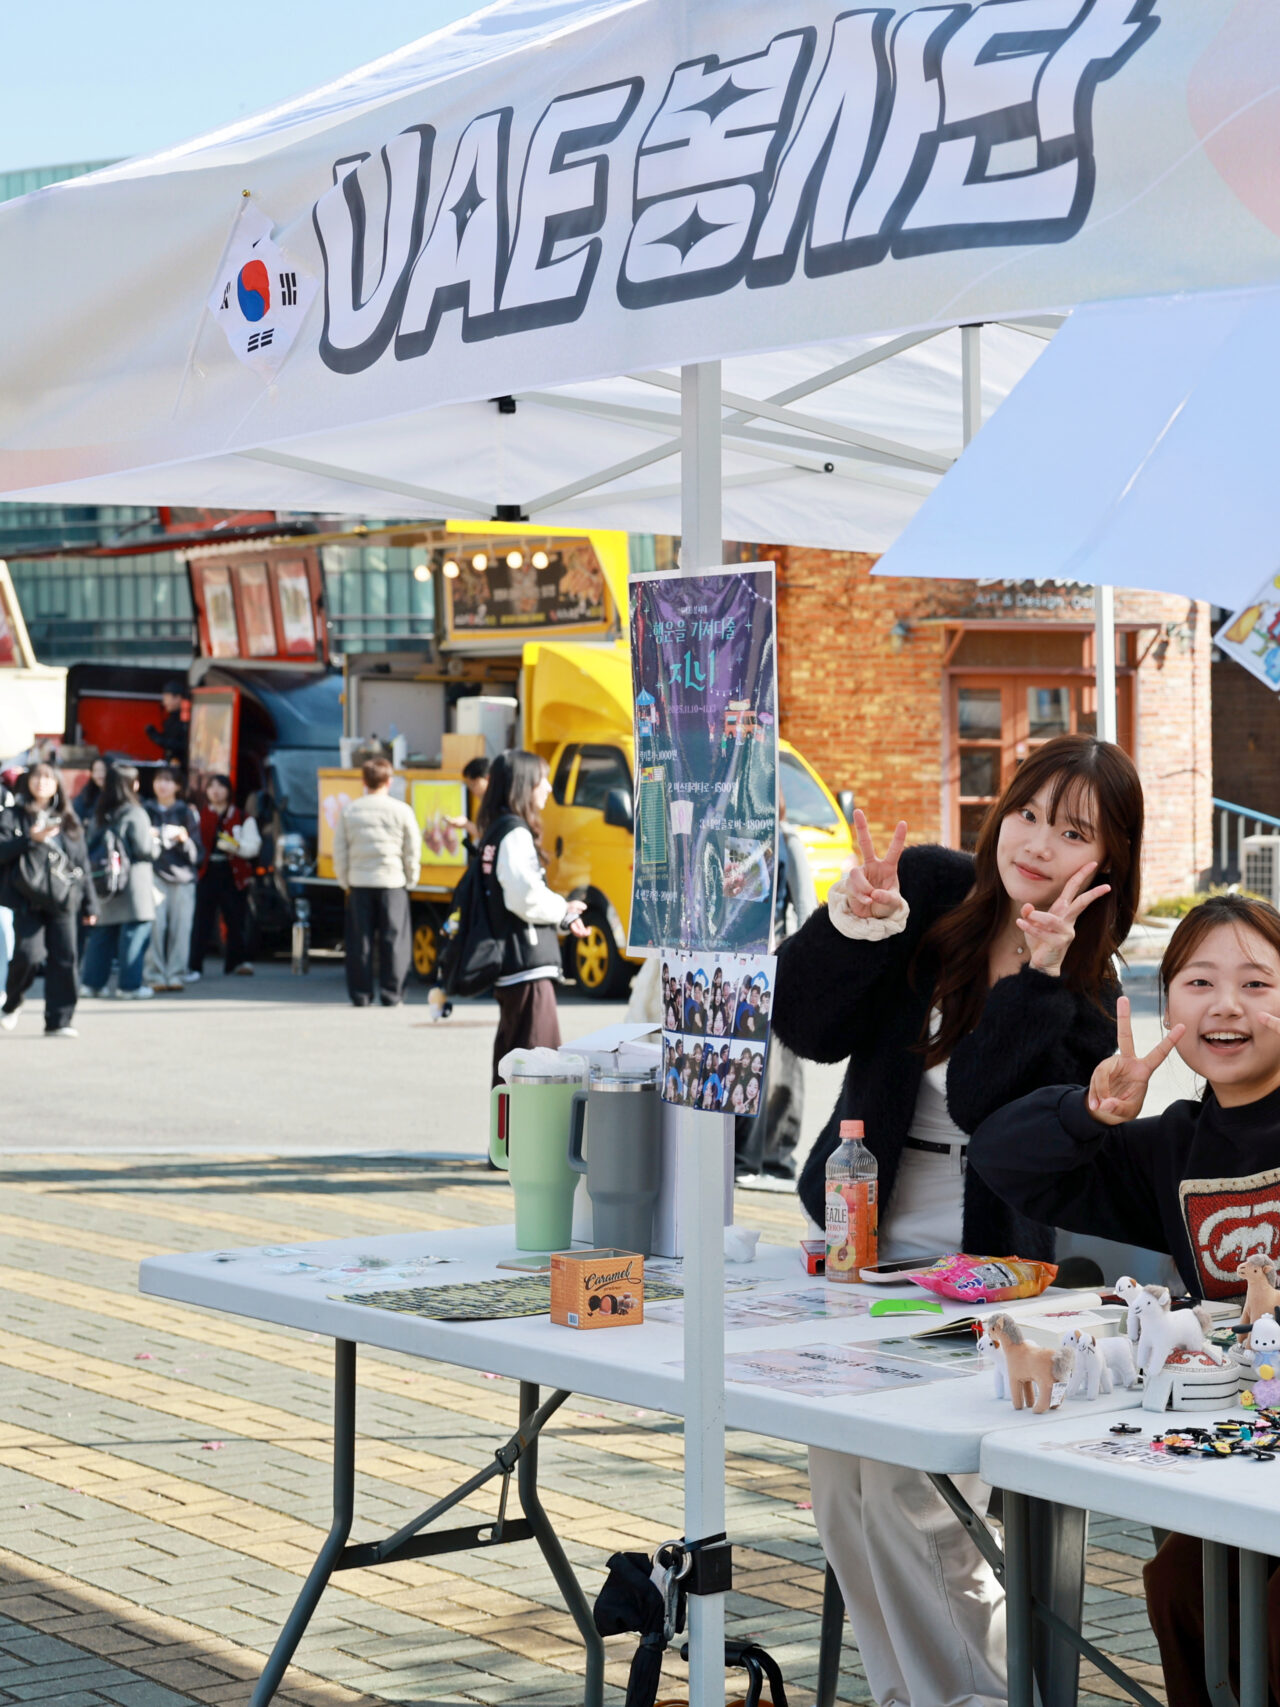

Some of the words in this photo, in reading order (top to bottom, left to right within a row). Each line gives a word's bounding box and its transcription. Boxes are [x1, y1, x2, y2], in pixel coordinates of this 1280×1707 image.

[653, 620, 687, 644] 행운을
[691, 616, 736, 641] 가져다줄
[668, 649, 716, 691] 지니
[584, 1260, 641, 1292] Caramel
